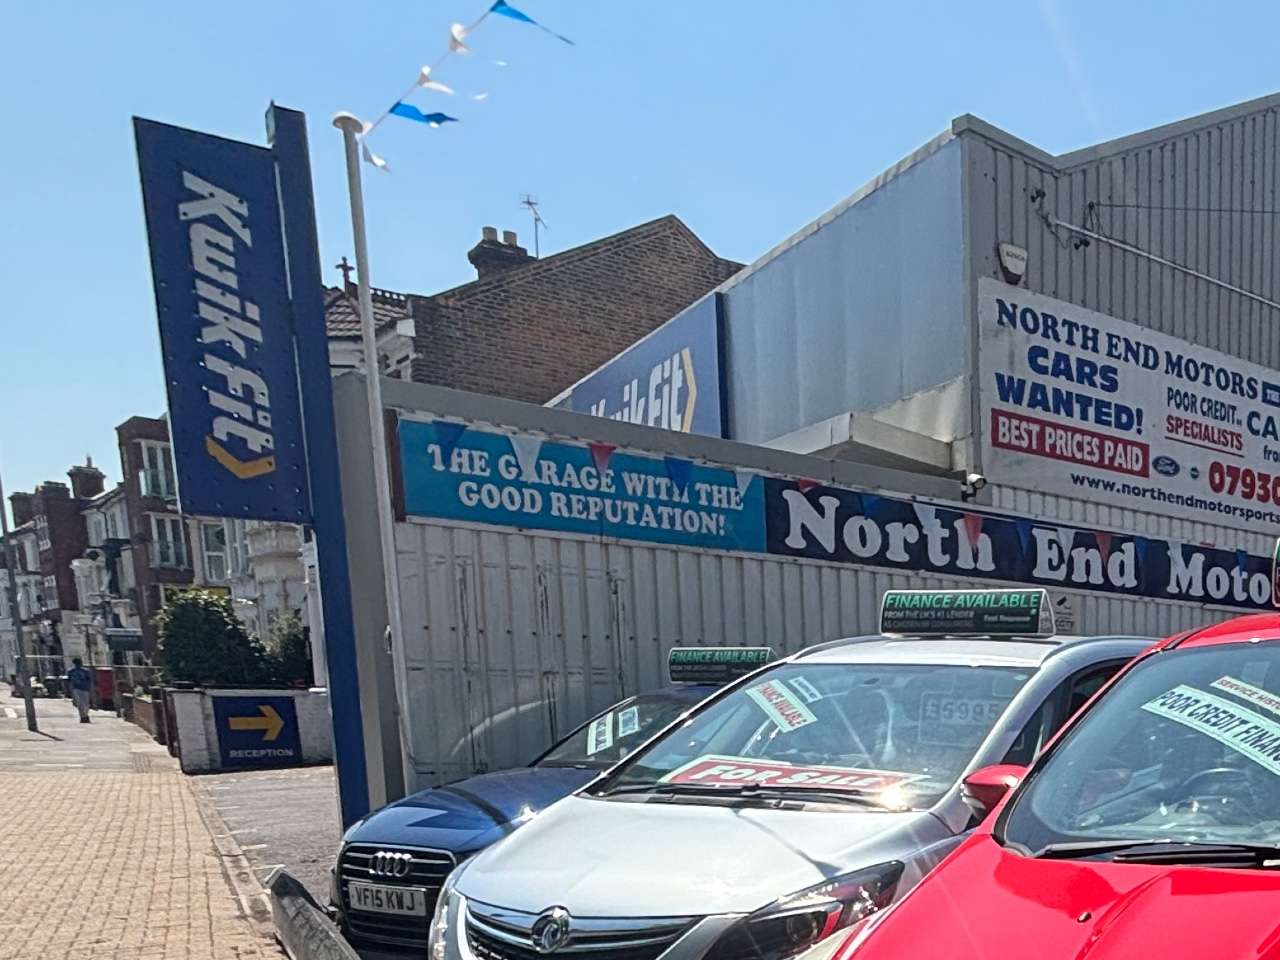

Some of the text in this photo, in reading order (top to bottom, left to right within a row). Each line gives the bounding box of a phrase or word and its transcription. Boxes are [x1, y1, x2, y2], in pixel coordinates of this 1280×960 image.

[178, 170, 263, 359] Kwik
[996, 299, 1258, 399] NORTH END MOTORS
[1028, 345, 1118, 393] CARS
[995, 373, 1143, 435] WANTED!
[1167, 387, 1197, 414] POOR
[999, 416, 1040, 449] BEST
[1045, 426, 1099, 464] PRICES
[1104, 441, 1143, 471] PAID
[1167, 415, 1242, 450] SPECIALISTS
[458, 481, 726, 536] GOOD REPUTATION!
[695, 482, 744, 511] THE
[784, 489, 995, 573] North
[1032, 527, 1137, 589] End
[885, 592, 1040, 609] FINANCE AVAILABLE
[1217, 678, 1257, 698] SERVICE
[1152, 690, 1197, 715] POOR
[1186, 701, 1250, 734] CREDIT
[229, 748, 294, 759] RECEPTION
[689, 765, 881, 787] FOR SALE
